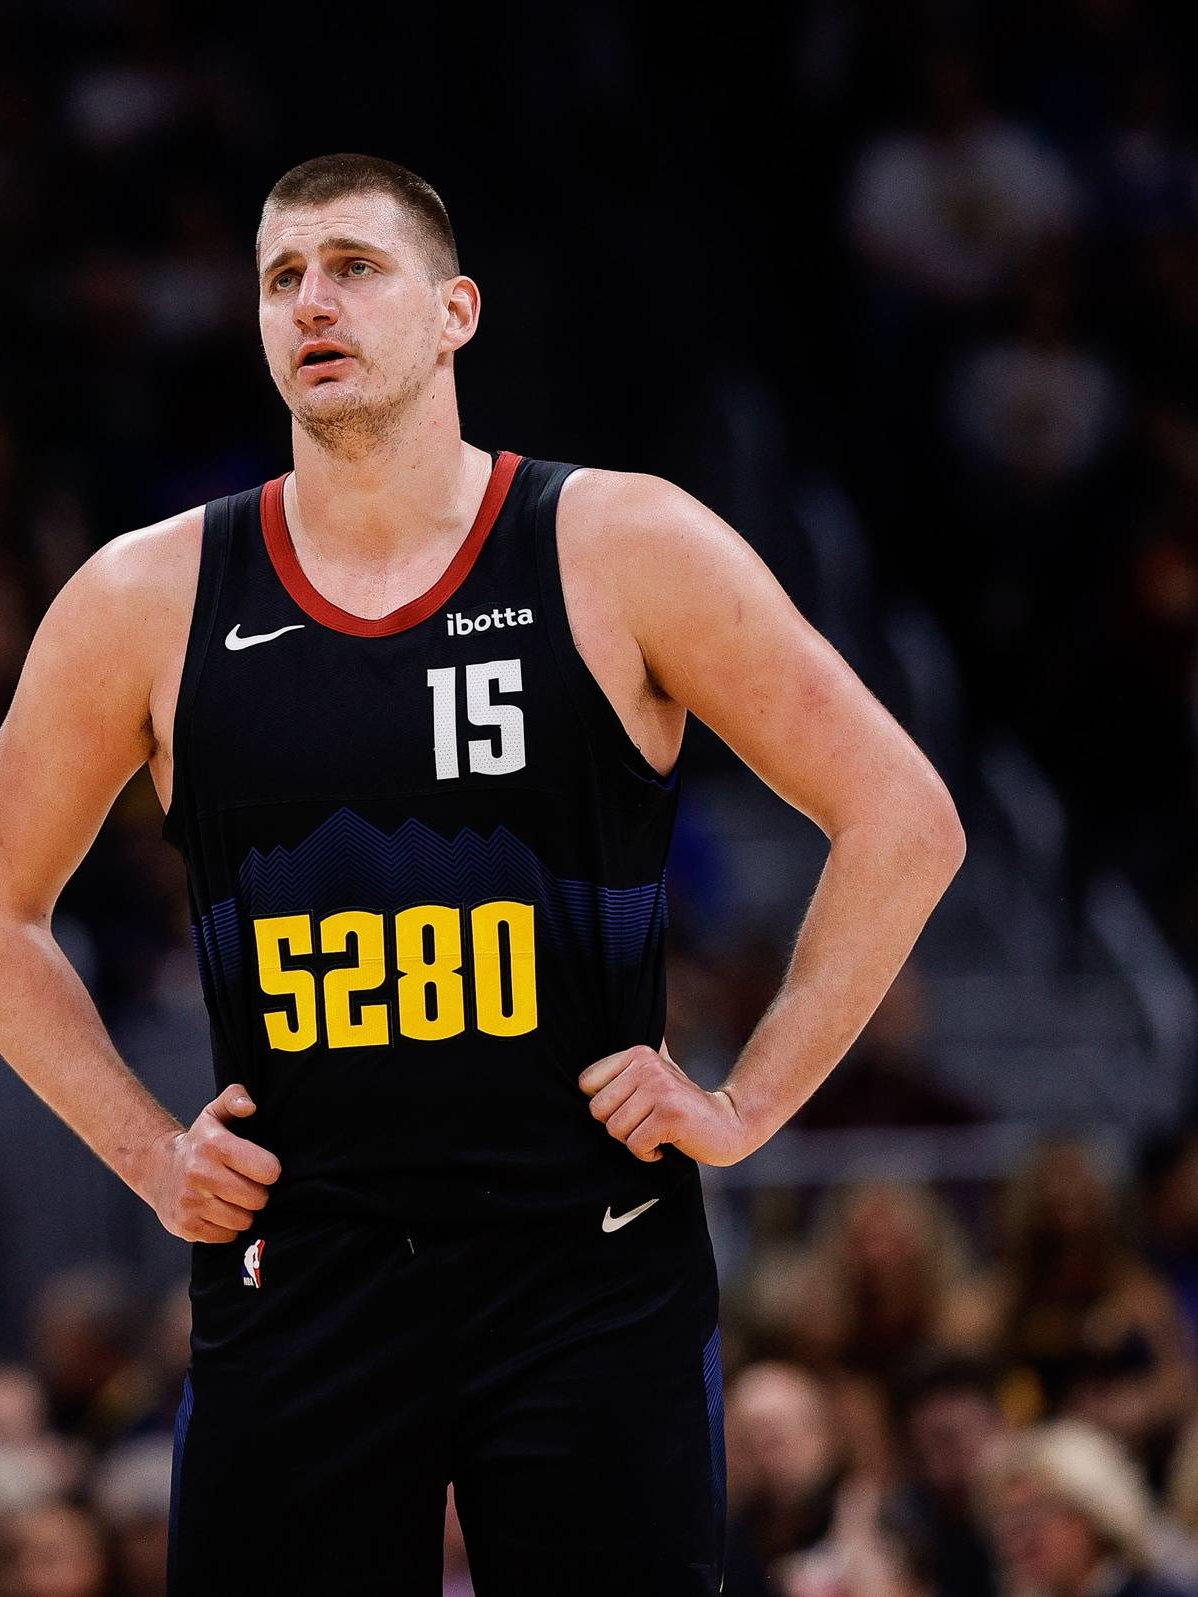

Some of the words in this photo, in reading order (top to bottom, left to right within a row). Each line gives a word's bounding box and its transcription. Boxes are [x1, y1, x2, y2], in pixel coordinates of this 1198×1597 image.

[446, 606, 533, 636] ibotta
[427, 659, 526, 780] 15
[253, 900, 538, 1052] 5280
